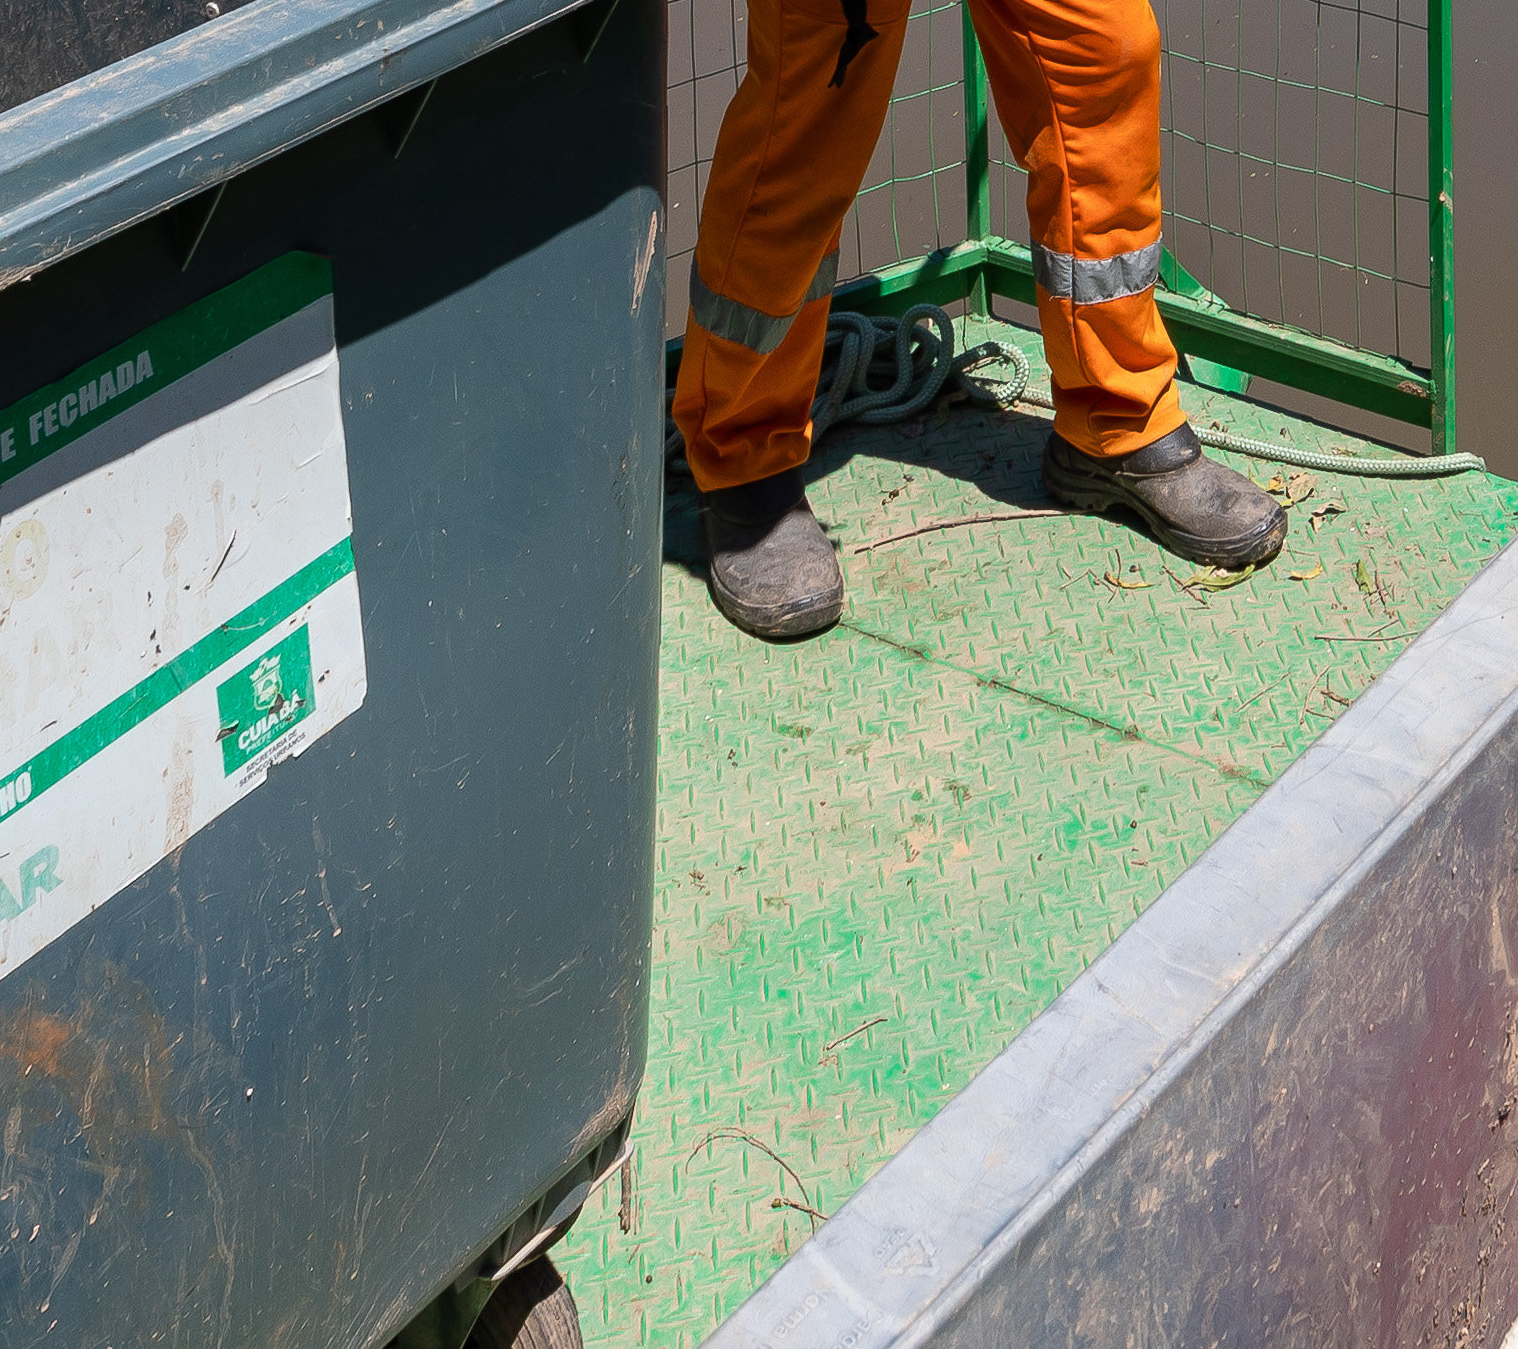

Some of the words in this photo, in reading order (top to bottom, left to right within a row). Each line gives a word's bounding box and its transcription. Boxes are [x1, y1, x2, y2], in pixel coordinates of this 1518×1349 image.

[29, 350, 154, 446] FECHADA
[237, 688, 304, 751] CUIABÁ
[245, 711, 297, 755] PREFEITUA
